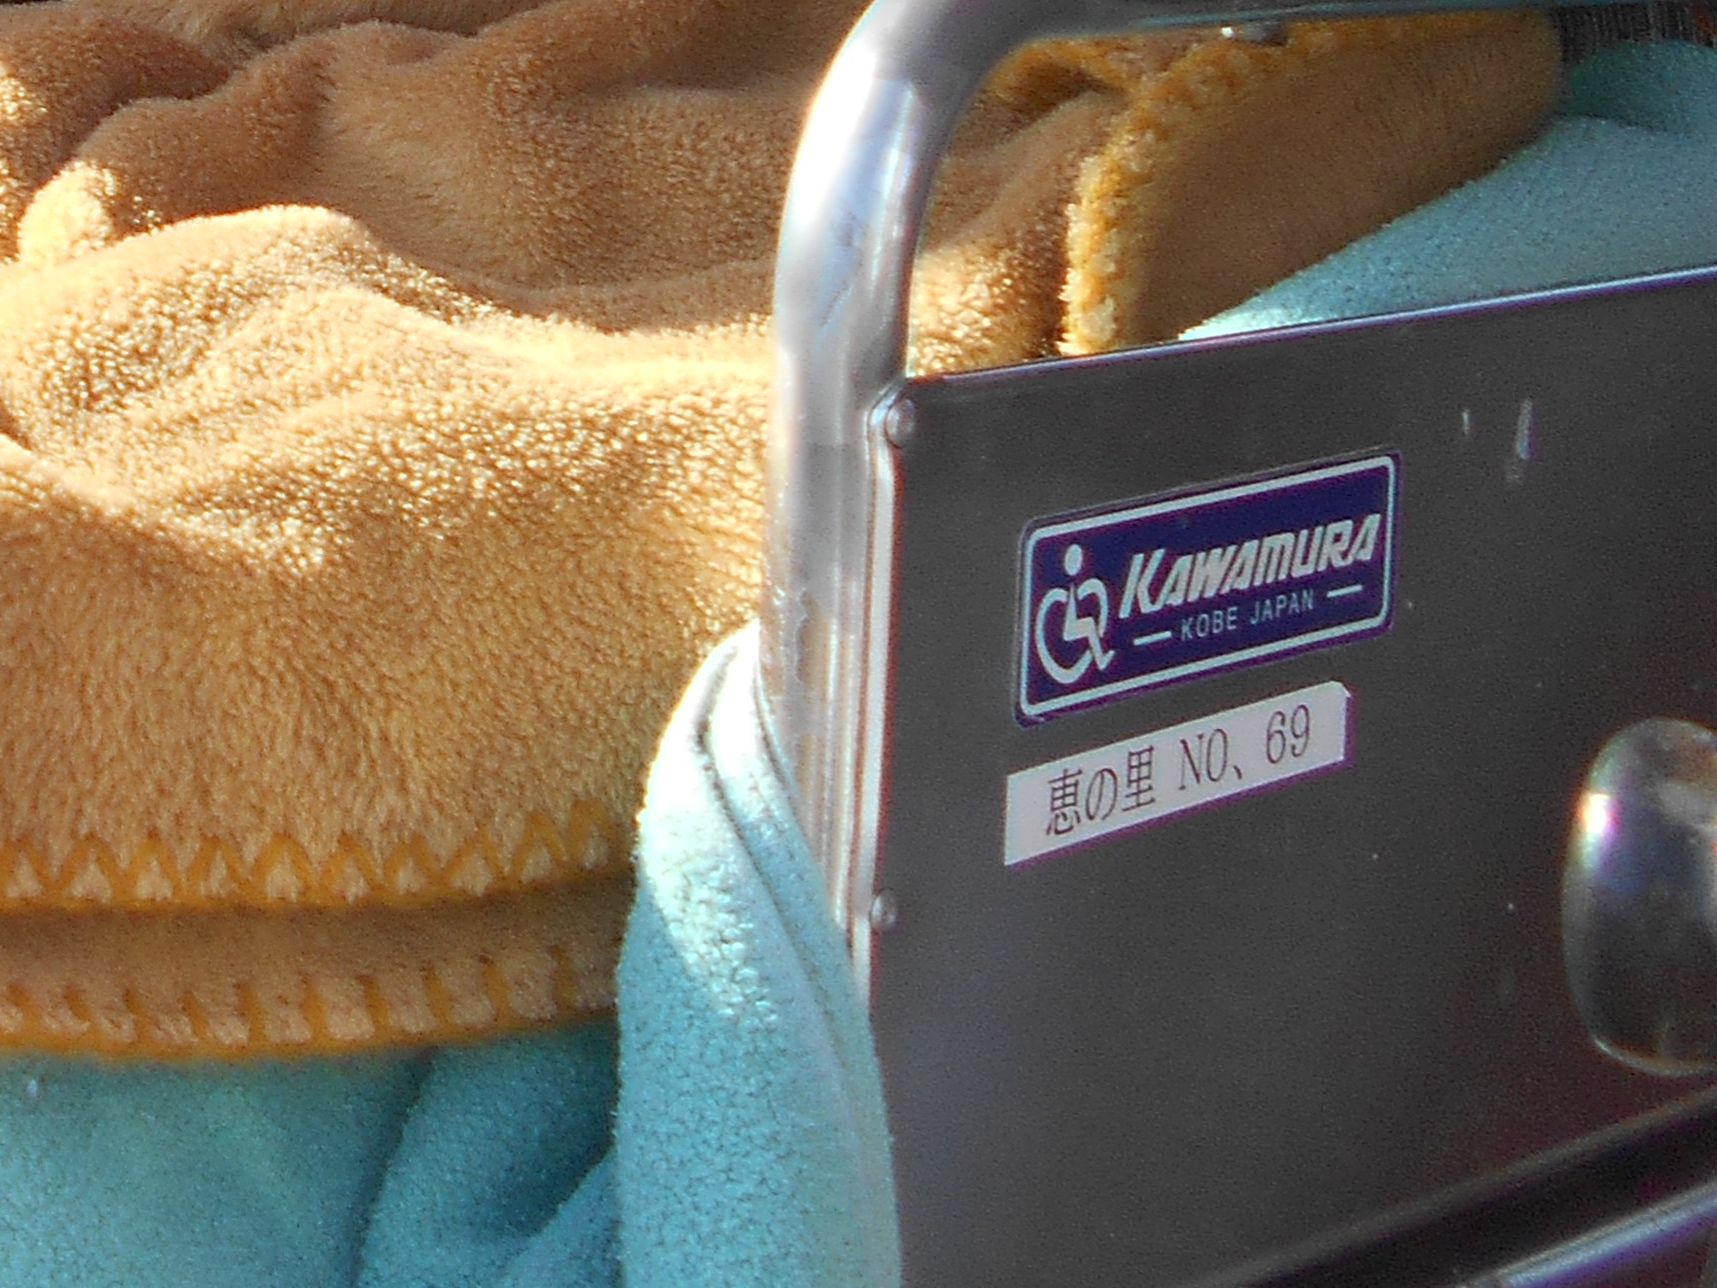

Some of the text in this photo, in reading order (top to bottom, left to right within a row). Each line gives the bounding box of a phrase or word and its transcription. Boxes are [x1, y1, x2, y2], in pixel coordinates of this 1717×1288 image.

[1119, 513, 1381, 619] KAWAMURA
[1181, 588, 1314, 642] KOBE JAPAN
[1045, 744, 1156, 836] 恵の里
